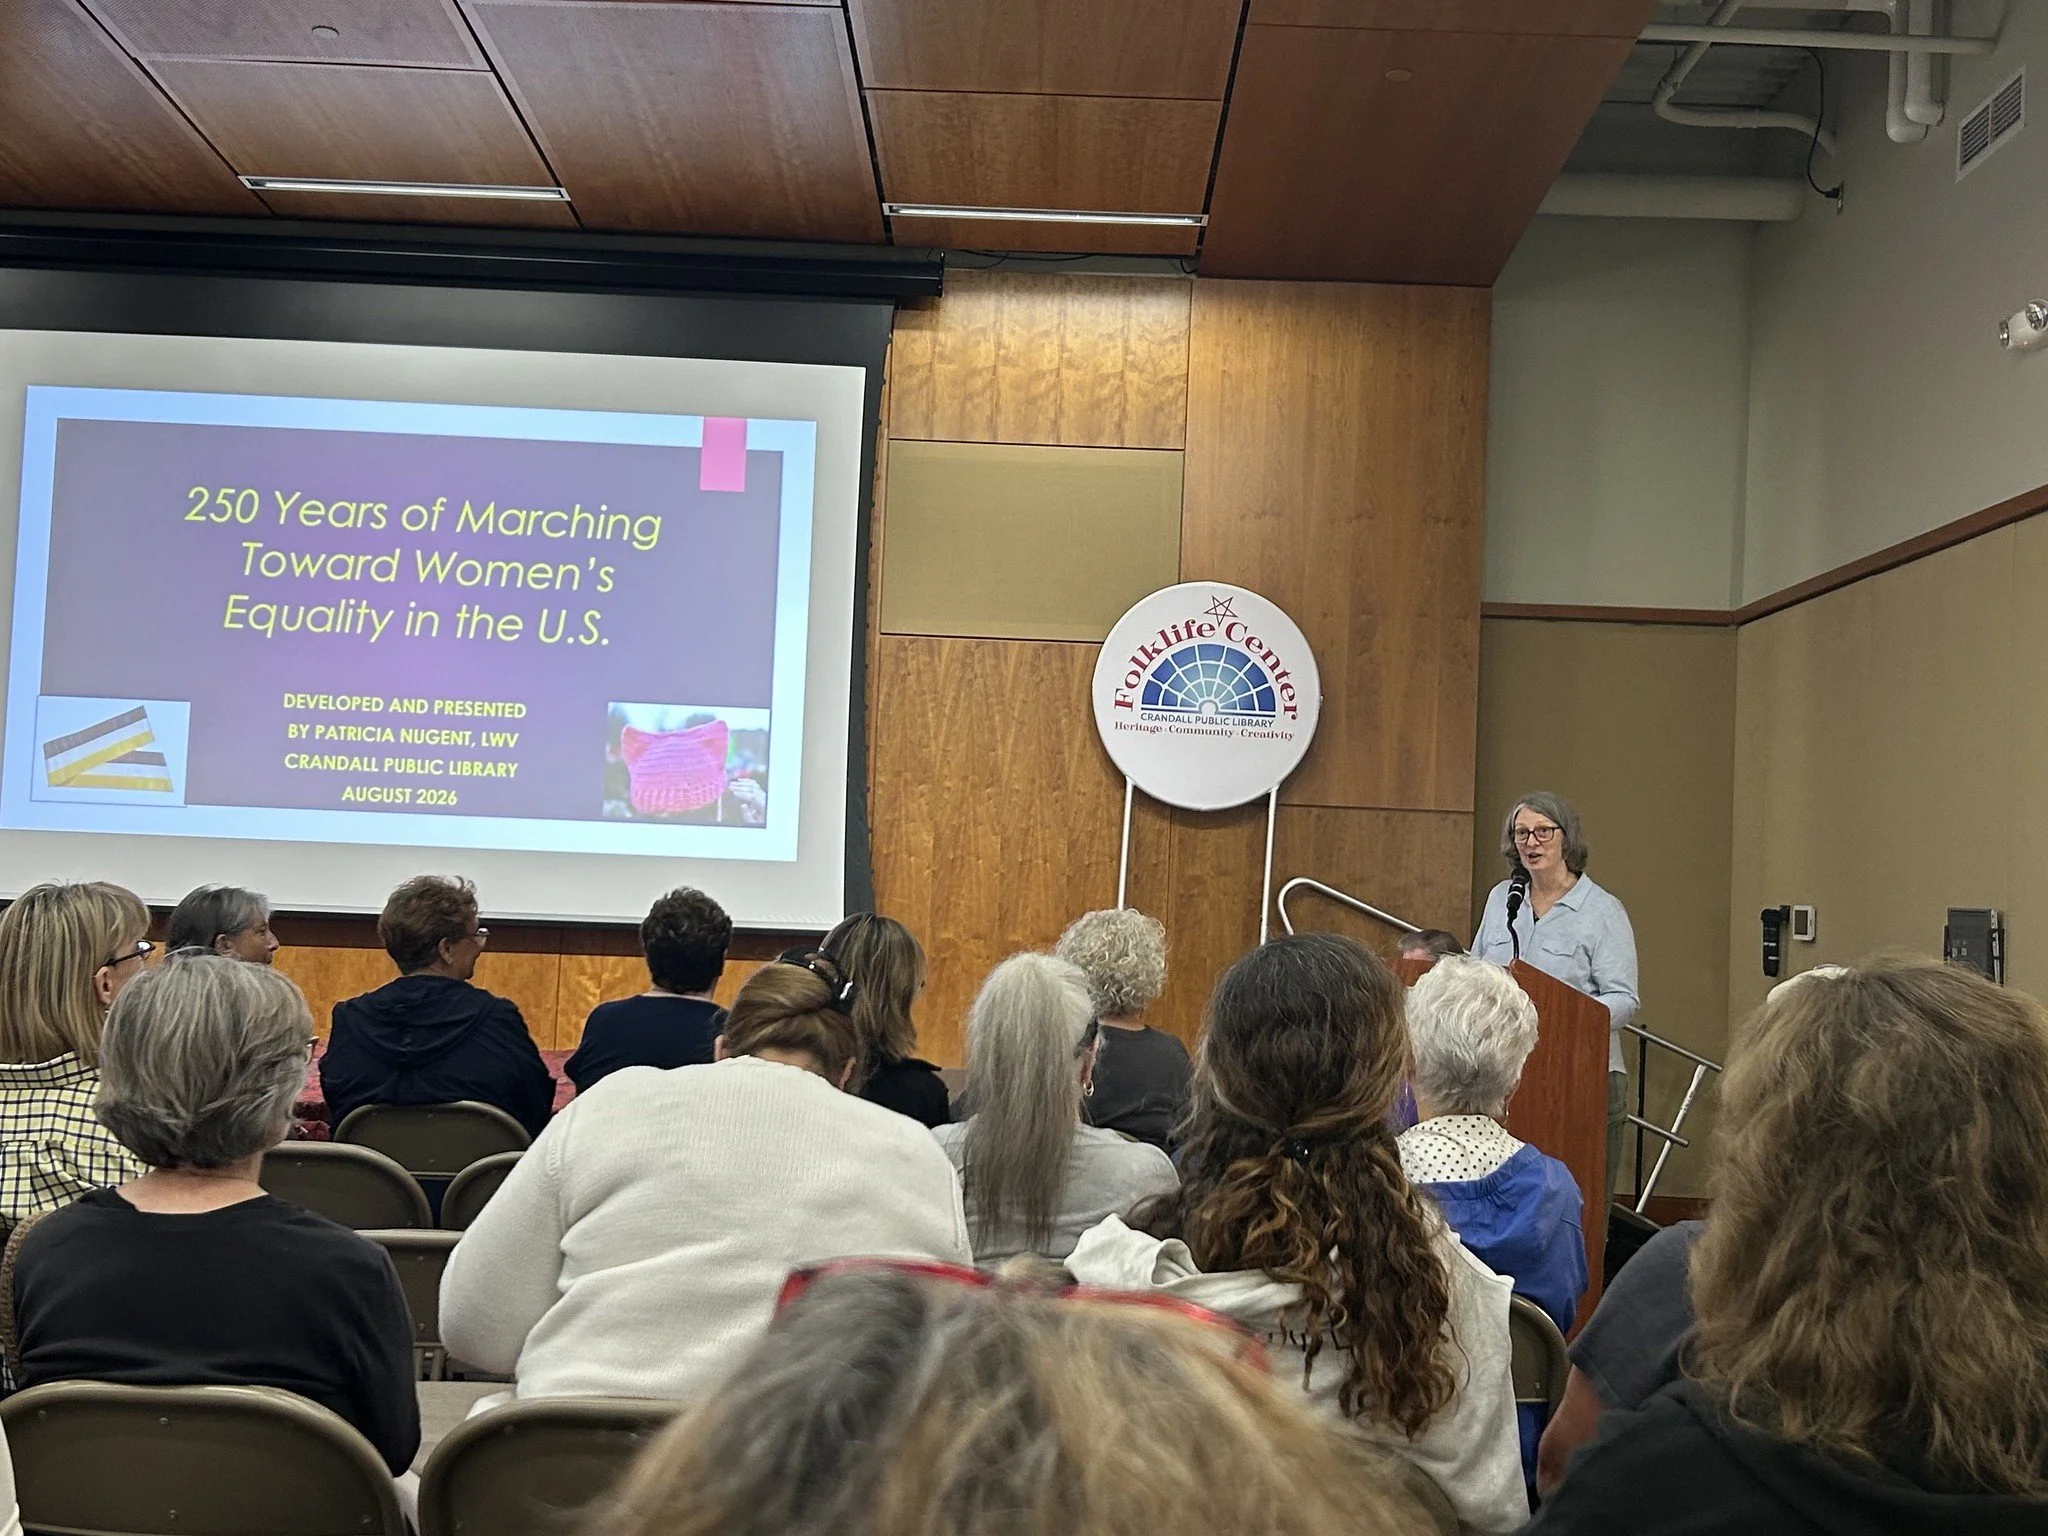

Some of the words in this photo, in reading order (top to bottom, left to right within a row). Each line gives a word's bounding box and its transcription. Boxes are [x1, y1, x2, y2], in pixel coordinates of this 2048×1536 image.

[184, 486, 260, 524] 250
[273, 490, 389, 530] Years
[401, 496, 448, 532] of
[455, 500, 663, 551] Marching
[241, 541, 401, 583] Toward
[415, 549, 616, 593] Women's
[222, 593, 395, 644] Equality
[404, 601, 440, 638] in
[456, 604, 524, 642] the
[538, 609, 610, 646] U.S.
[1114, 619, 1216, 712] Folklife
[1224, 621, 1299, 721] Center
[283, 693, 384, 712] DEVELOPED
[388, 698, 430, 715] AND
[433, 701, 528, 719] PRESENTED
[1114, 721, 1163, 734] Heritage
[1168, 724, 1235, 738] Community
[1240, 728, 1295, 742] Creativity
[1140, 712, 1192, 724] CRANDALL
[1194, 715, 1230, 727] PUBLIC
[1232, 717, 1275, 729] LIBRARY
[287, 723, 310, 740] BY
[315, 725, 395, 742] PATRICIA
[399, 728, 477, 749] NUGENT,
[481, 731, 520, 748] LWV
[284, 753, 379, 772] CRANDALL
[383, 757, 444, 776] PUBLIC
[448, 760, 519, 779] LIBRARY
[341, 786, 412, 803] AUGUST
[416, 789, 459, 807] 2026
